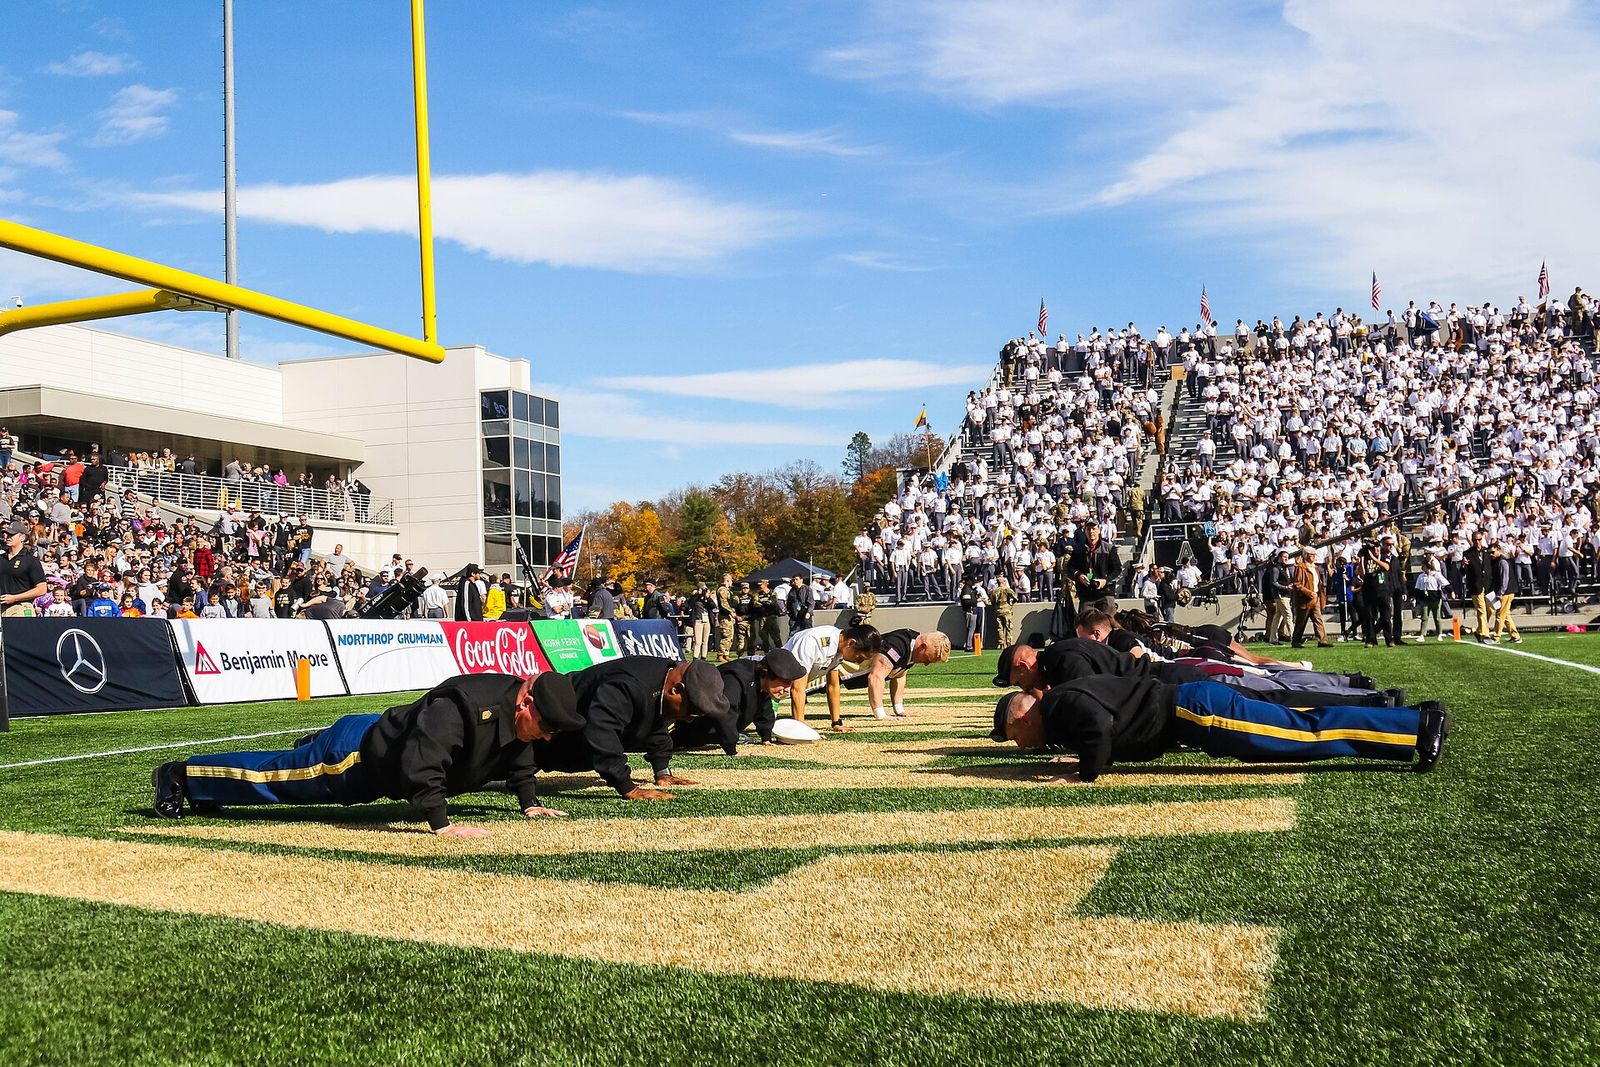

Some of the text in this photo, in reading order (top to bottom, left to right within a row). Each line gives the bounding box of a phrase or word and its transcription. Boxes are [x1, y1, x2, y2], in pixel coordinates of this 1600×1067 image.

[338, 633, 444, 646] NORTHROP GRUMMAN
[560, 637, 581, 646] FERRY
[641, 634, 682, 661] USAA
[220, 649, 286, 674] Benjamin
